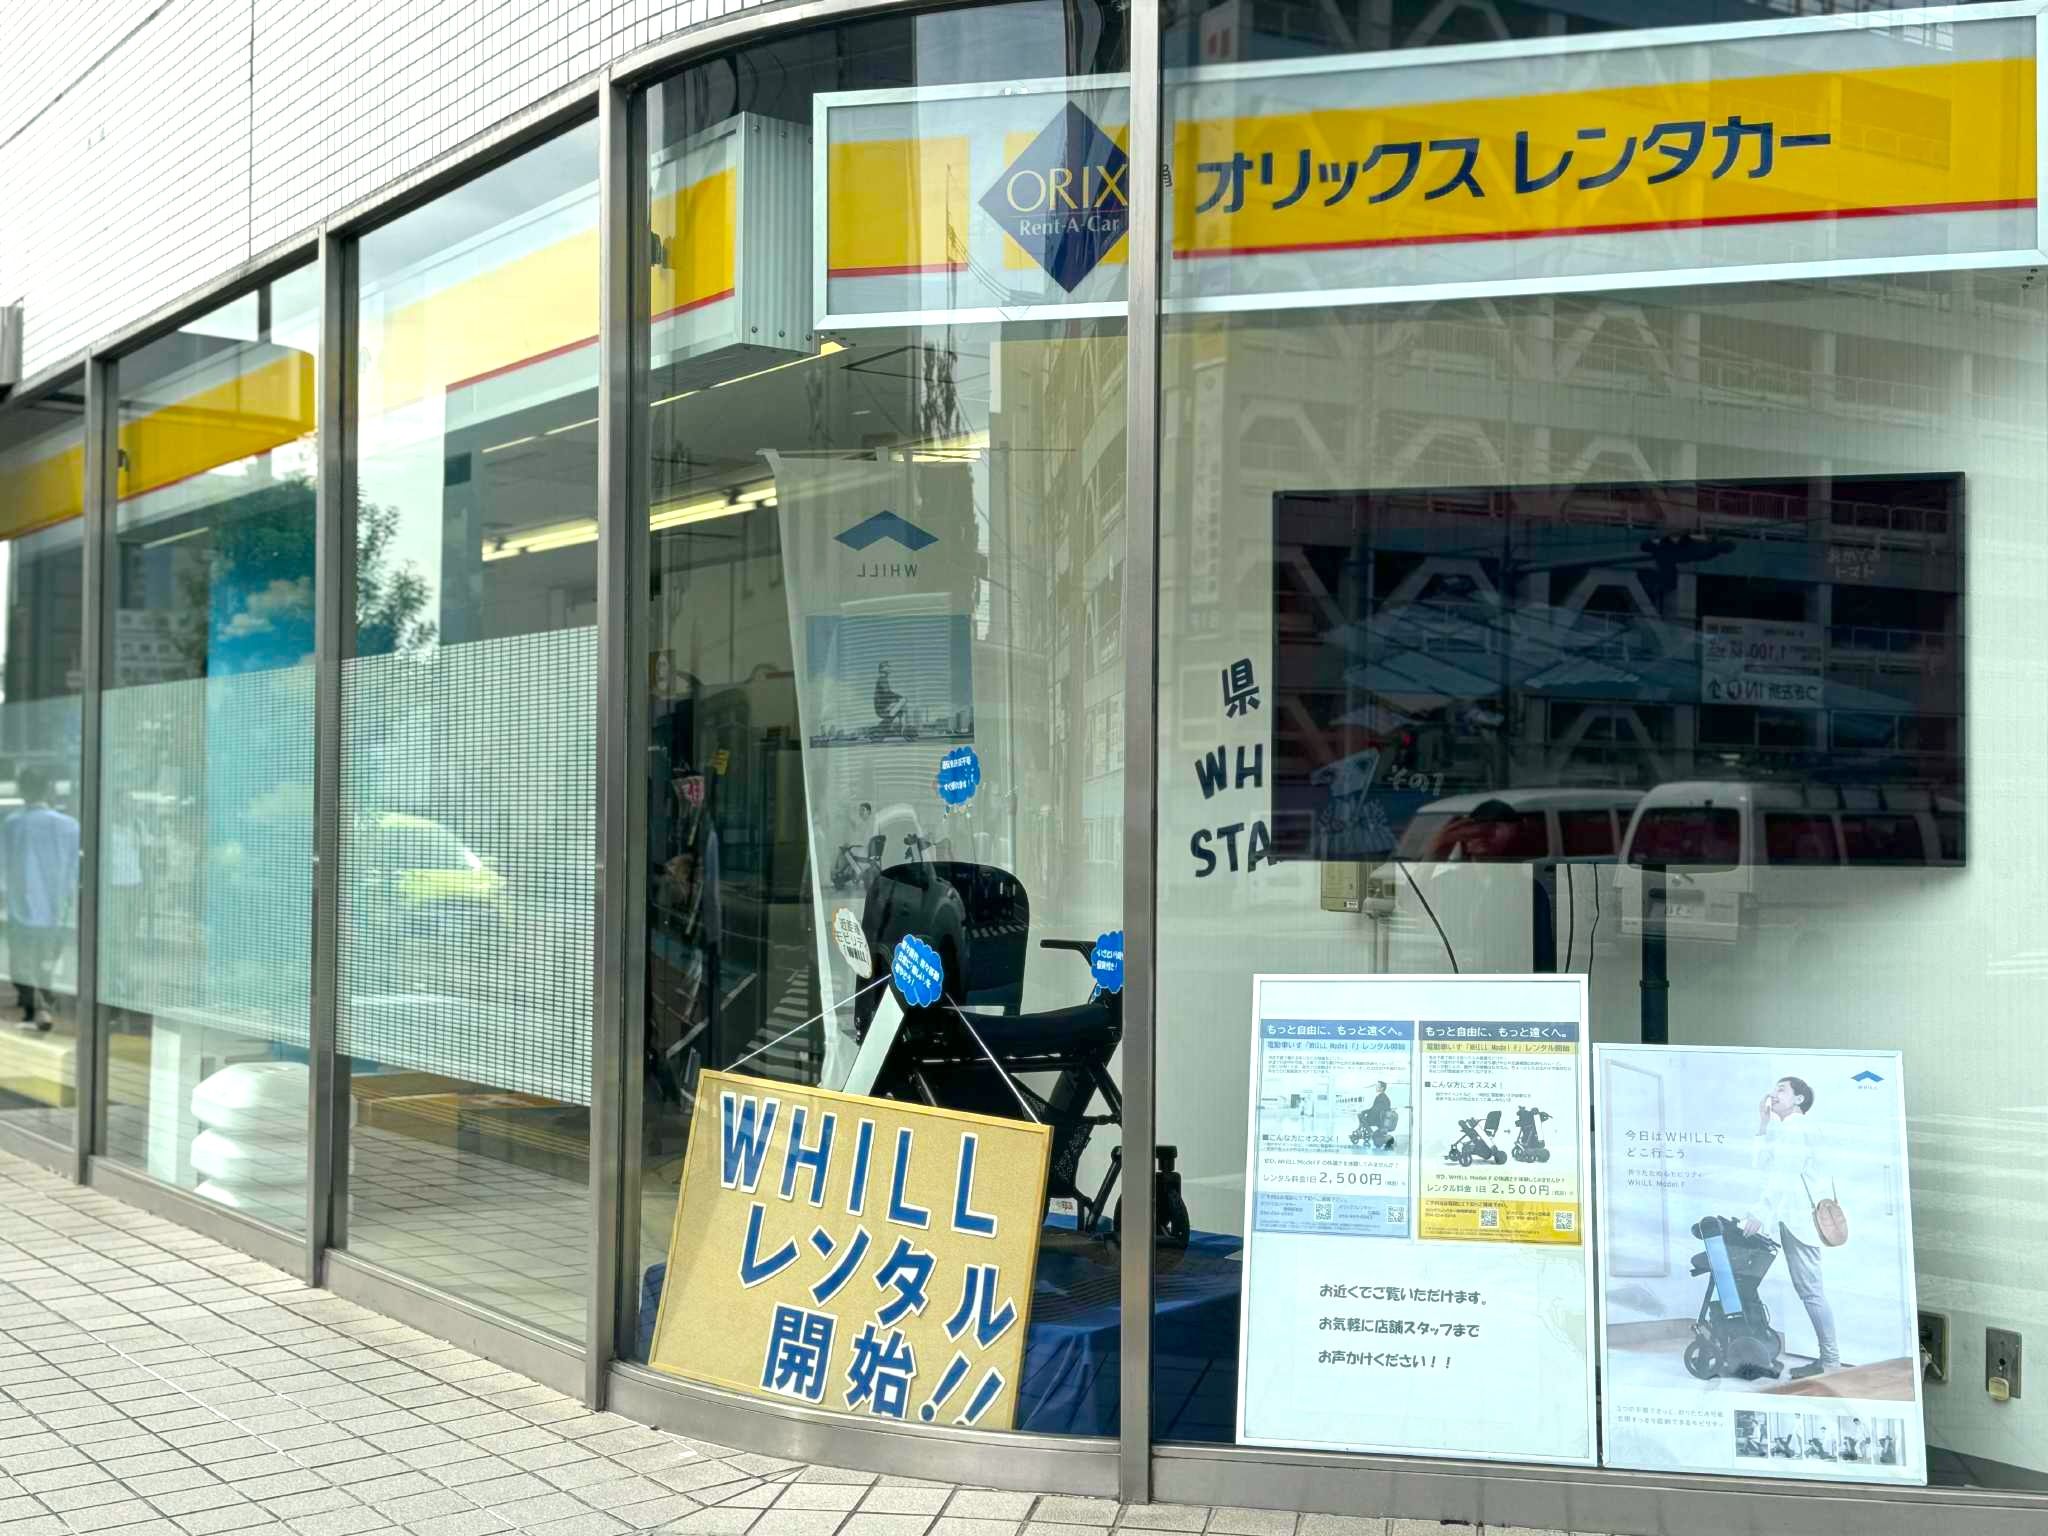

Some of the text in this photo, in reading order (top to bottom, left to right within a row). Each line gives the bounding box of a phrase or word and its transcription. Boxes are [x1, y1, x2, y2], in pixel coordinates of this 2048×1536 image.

[1195, 115, 1831, 214] オリックス レンタカー
[1006, 164, 1129, 212] ORIX
[1020, 216, 1120, 237] Rent-A-Car
[1625, 1130, 1725, 1144] 今日はWHILLで
[1626, 1147, 1686, 1159] どこ行こう
[721, 1091, 998, 1238] WHILL
[737, 1202, 1018, 1350] レンタル
[1319, 1284, 1487, 1306] お近くでご覧いただけます。
[1318, 1316, 1480, 1338] お気軽に店舗スタッフまで
